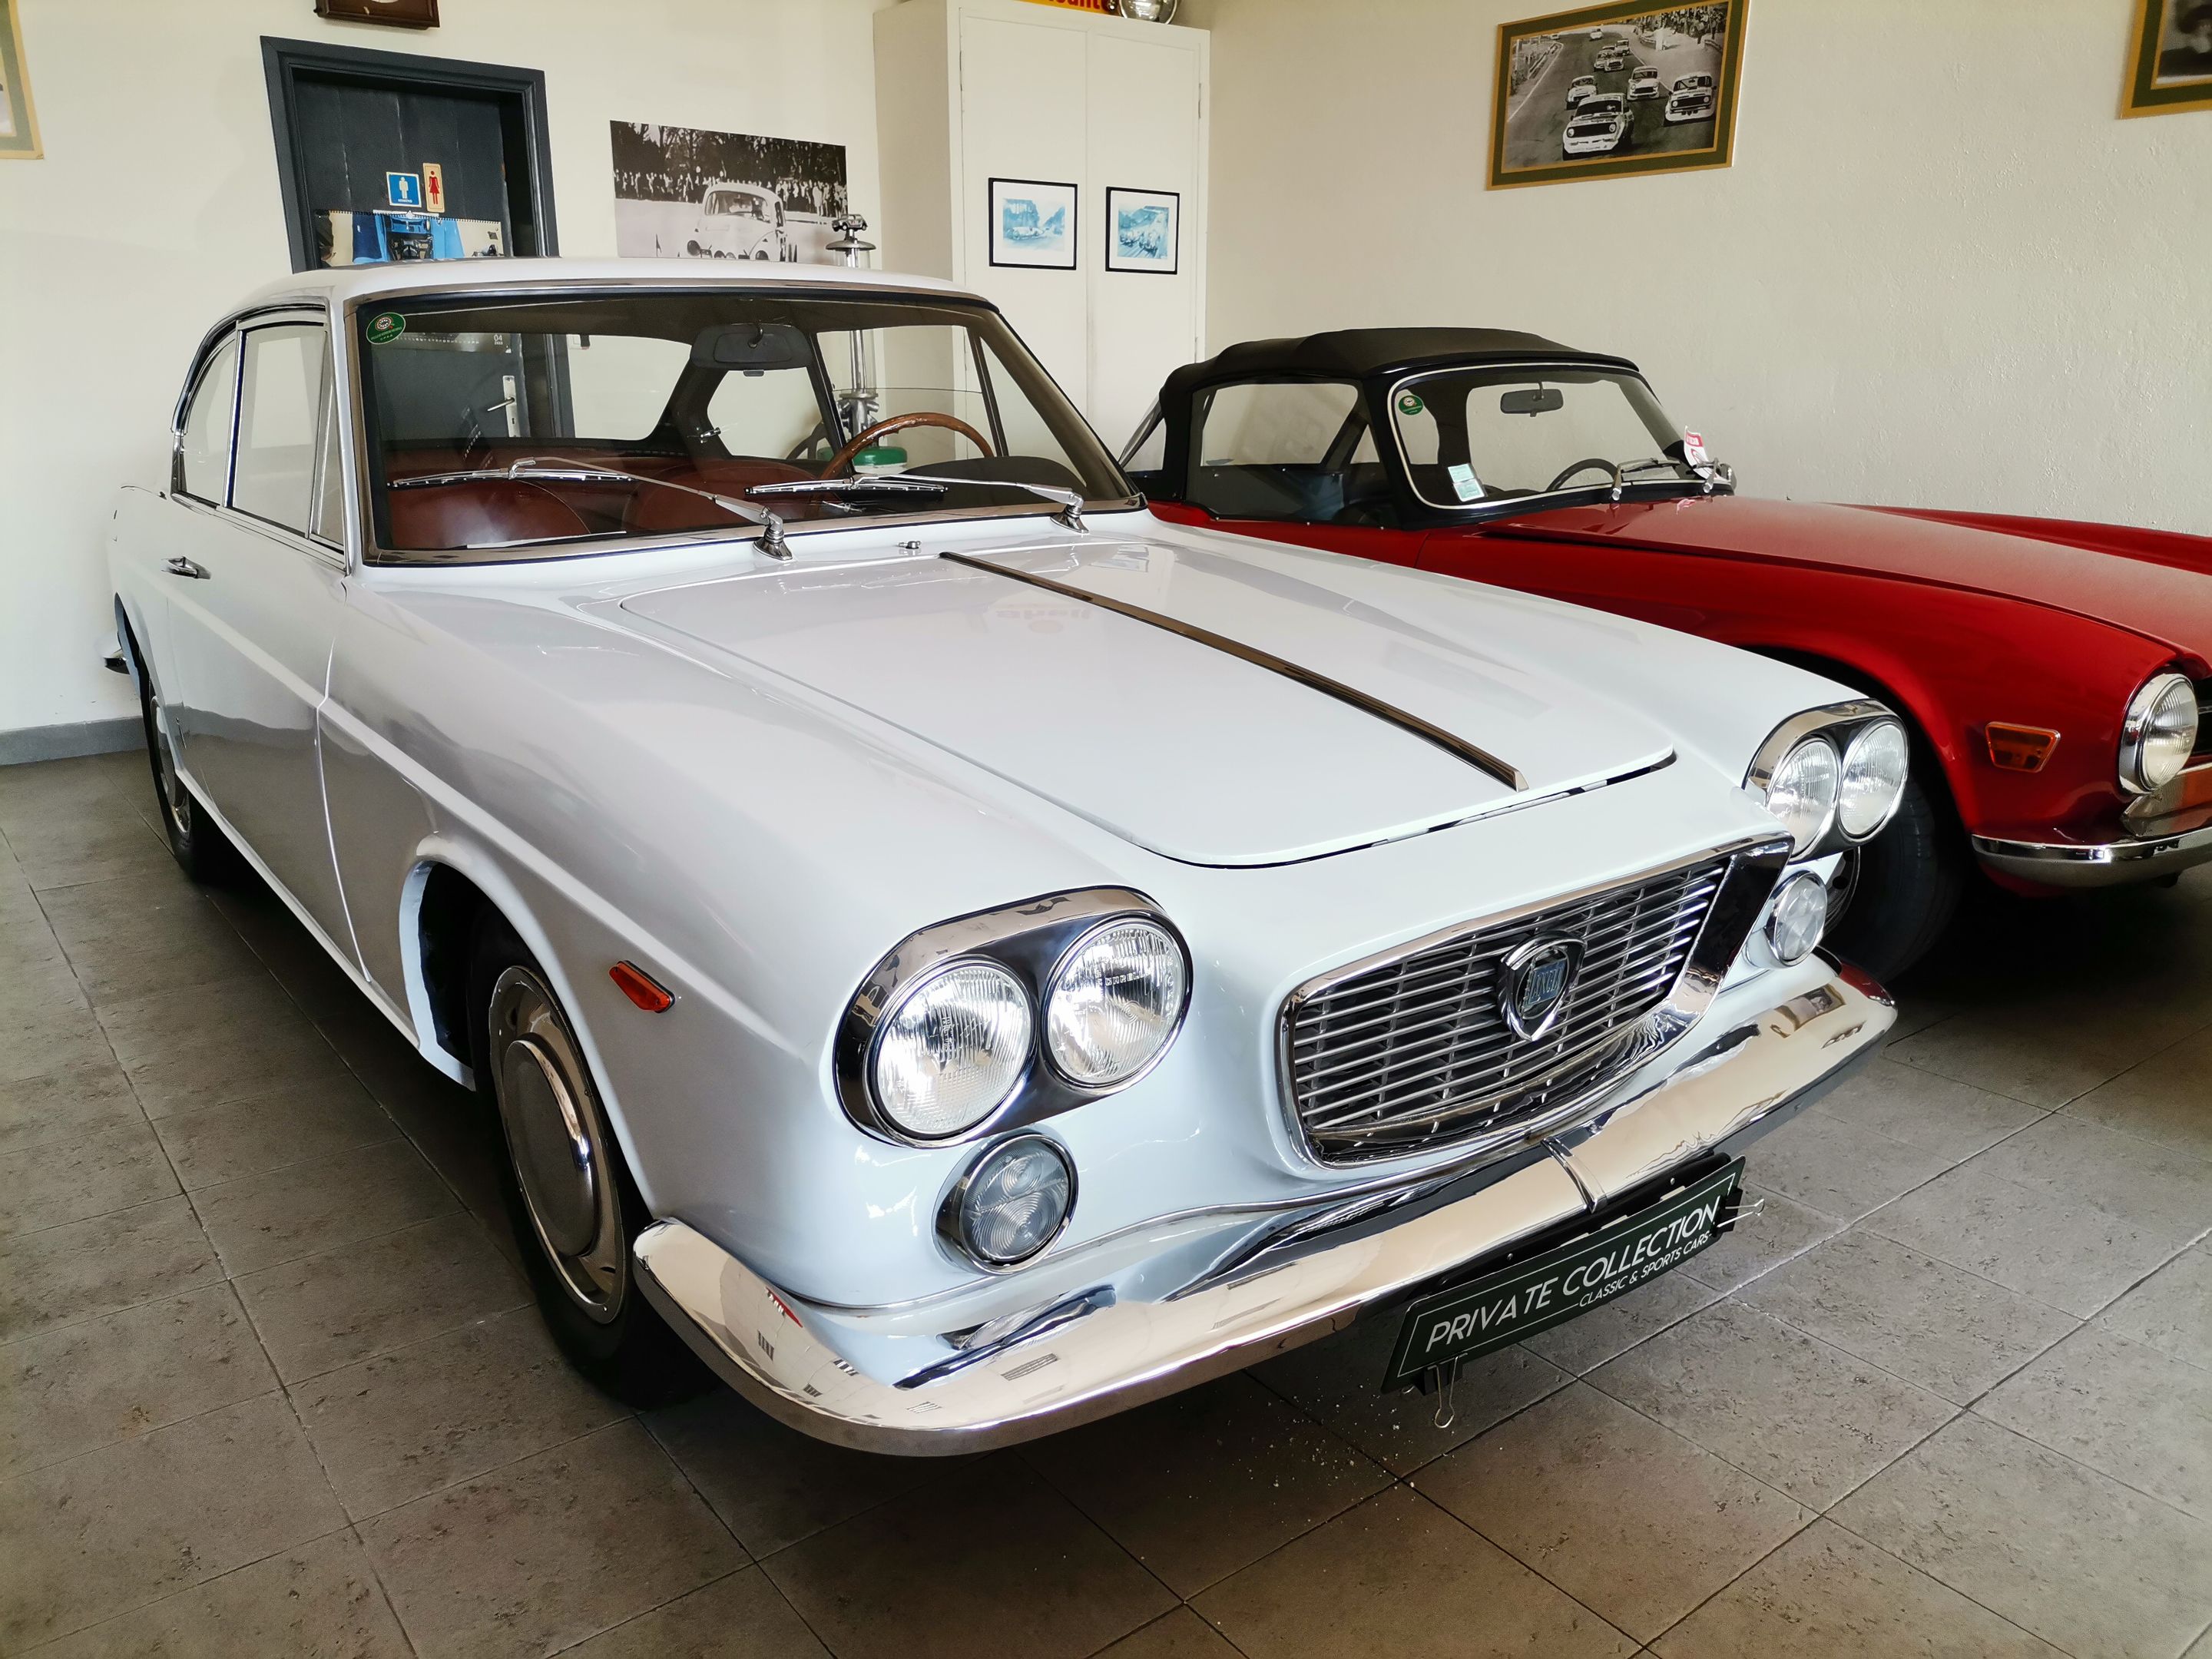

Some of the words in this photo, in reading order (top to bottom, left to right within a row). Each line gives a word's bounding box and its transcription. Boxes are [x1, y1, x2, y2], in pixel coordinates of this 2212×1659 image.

[1426, 1277, 1559, 1353] PRIVATE
[1562, 1195, 1721, 1296] COLLECTION
[1579, 1275, 1628, 1307] CLASSIC
[1629, 1270, 1638, 1284] &
[1641, 1247, 1682, 1279] SPORTS
[1683, 1230, 1709, 1255] CARS
